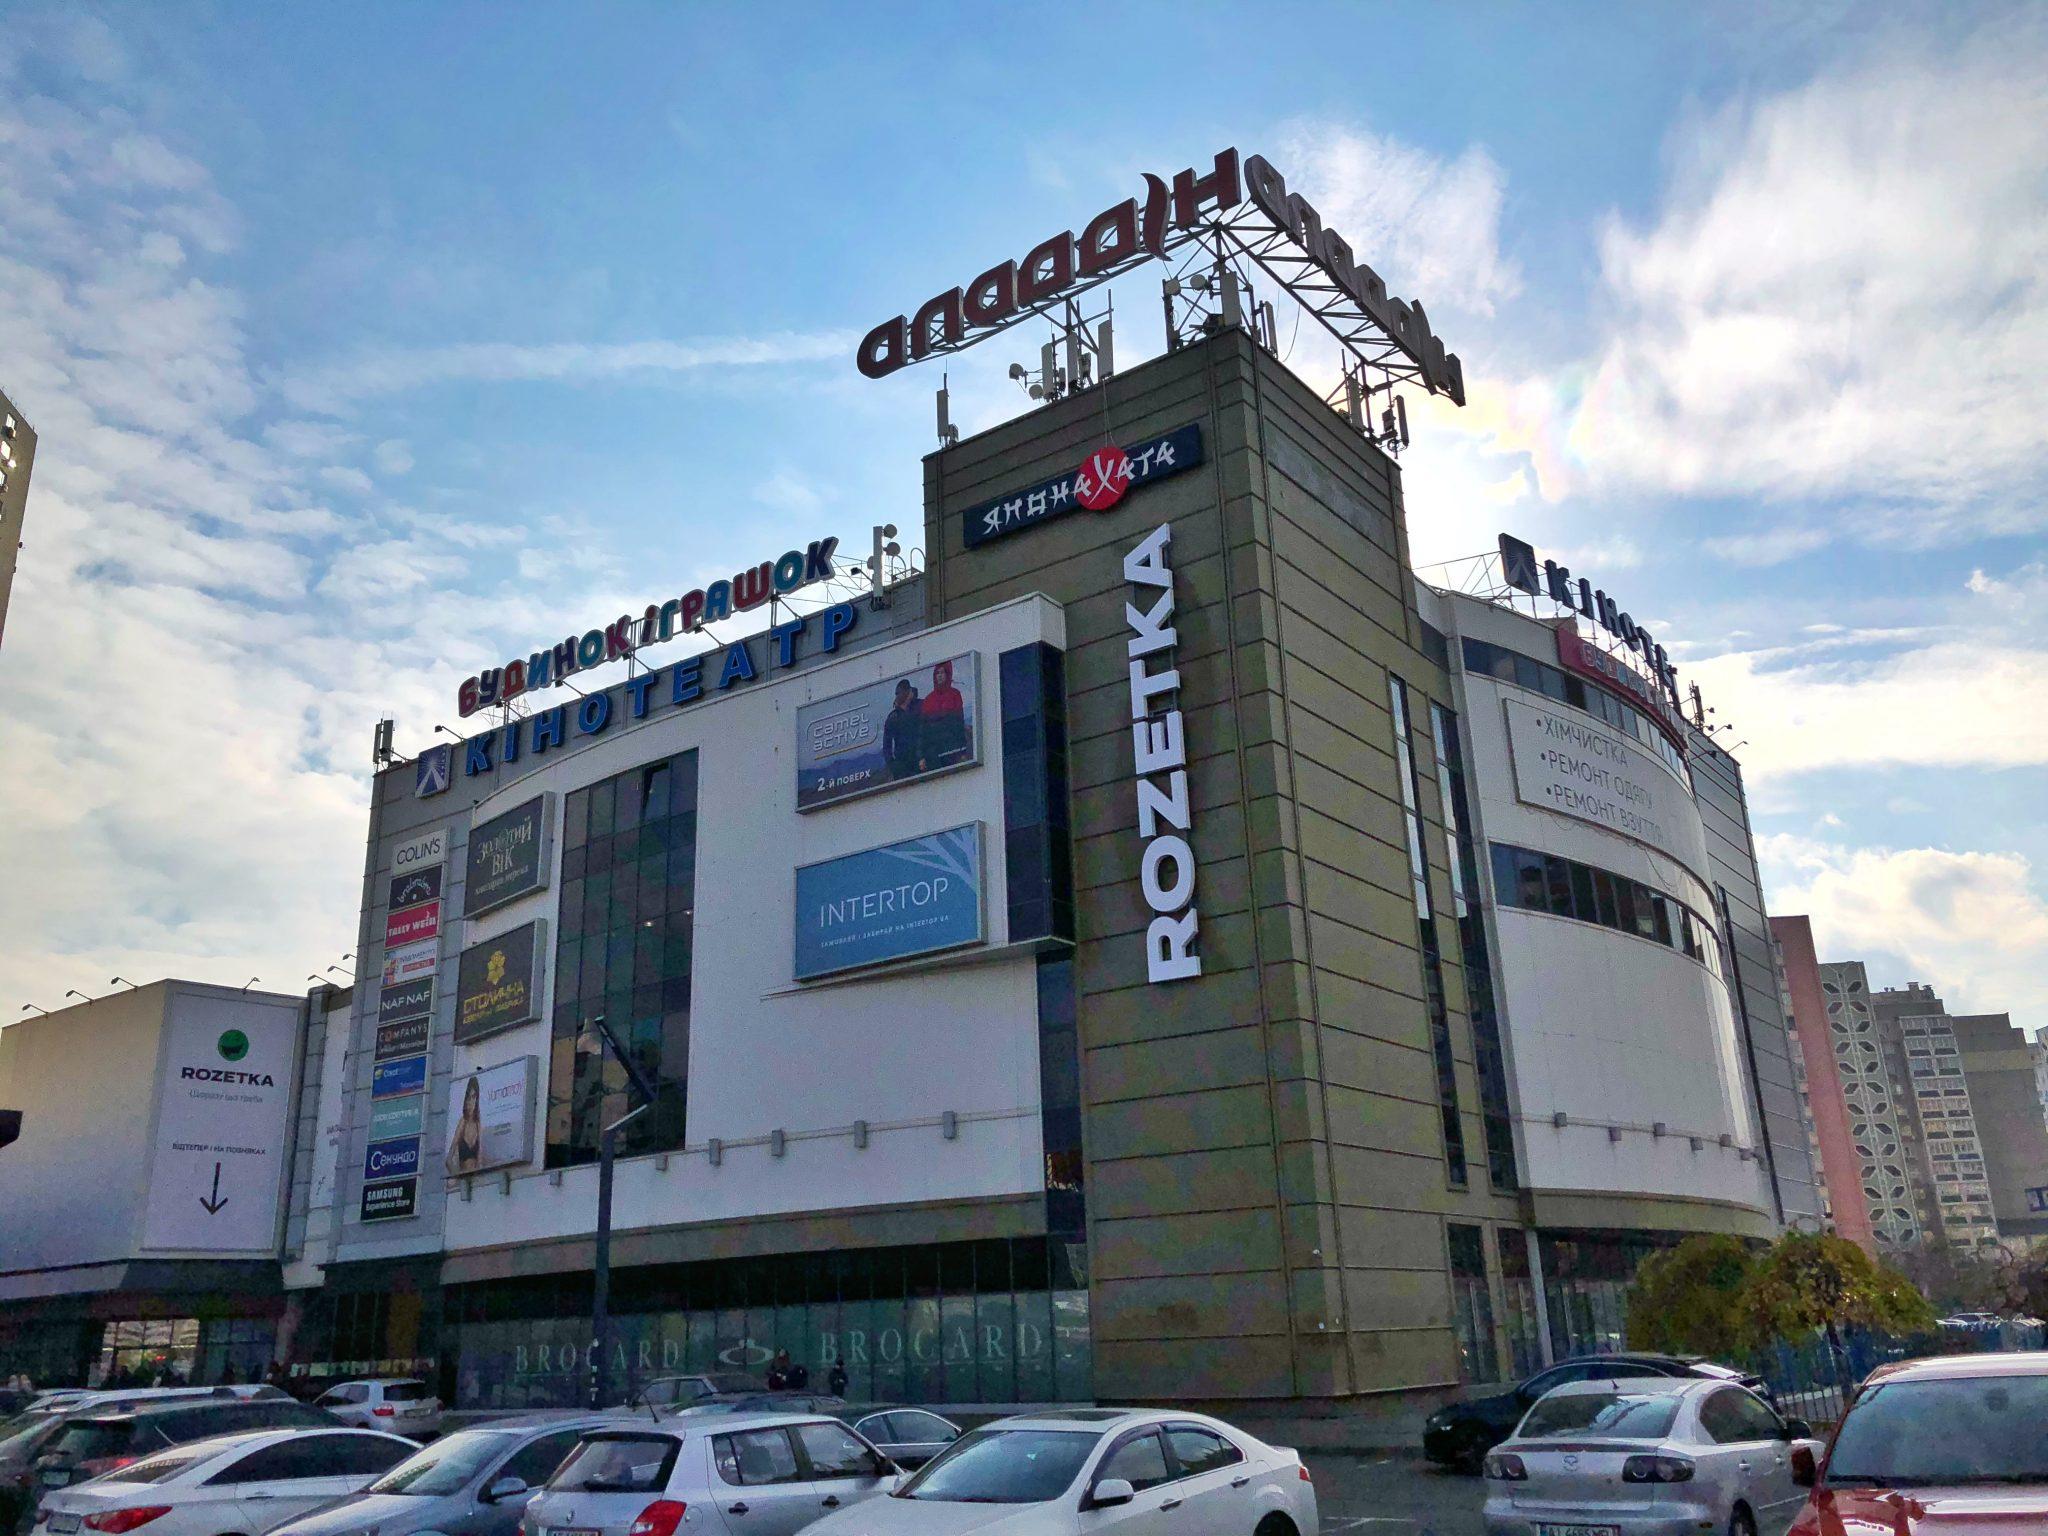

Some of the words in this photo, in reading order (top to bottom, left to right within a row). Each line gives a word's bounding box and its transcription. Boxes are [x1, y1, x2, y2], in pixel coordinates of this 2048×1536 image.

[458, 614, 632, 718] БУДИНОК
[465, 602, 858, 777] КІНОТЕАТР
[813, 712, 869, 738] camel
[814, 726, 869, 751] active
[1544, 715, 1628, 768] ХІМЧИСТКА
[1123, 522, 1202, 984] ROZETKA
[1549, 749, 1610, 790] РЕМОНТ
[1553, 783, 1616, 820] РЕМОНТ
[396, 837, 441, 865] COLIN'S
[820, 877, 949, 928] INTERTOP
[381, 995, 407, 1011] NAF
[406, 990, 431, 1004] NAF
[181, 1066, 274, 1087] ROZETKA
[366, 1186, 403, 1202] SAMSUNG
[819, 1322, 1043, 1364] BROCARD
